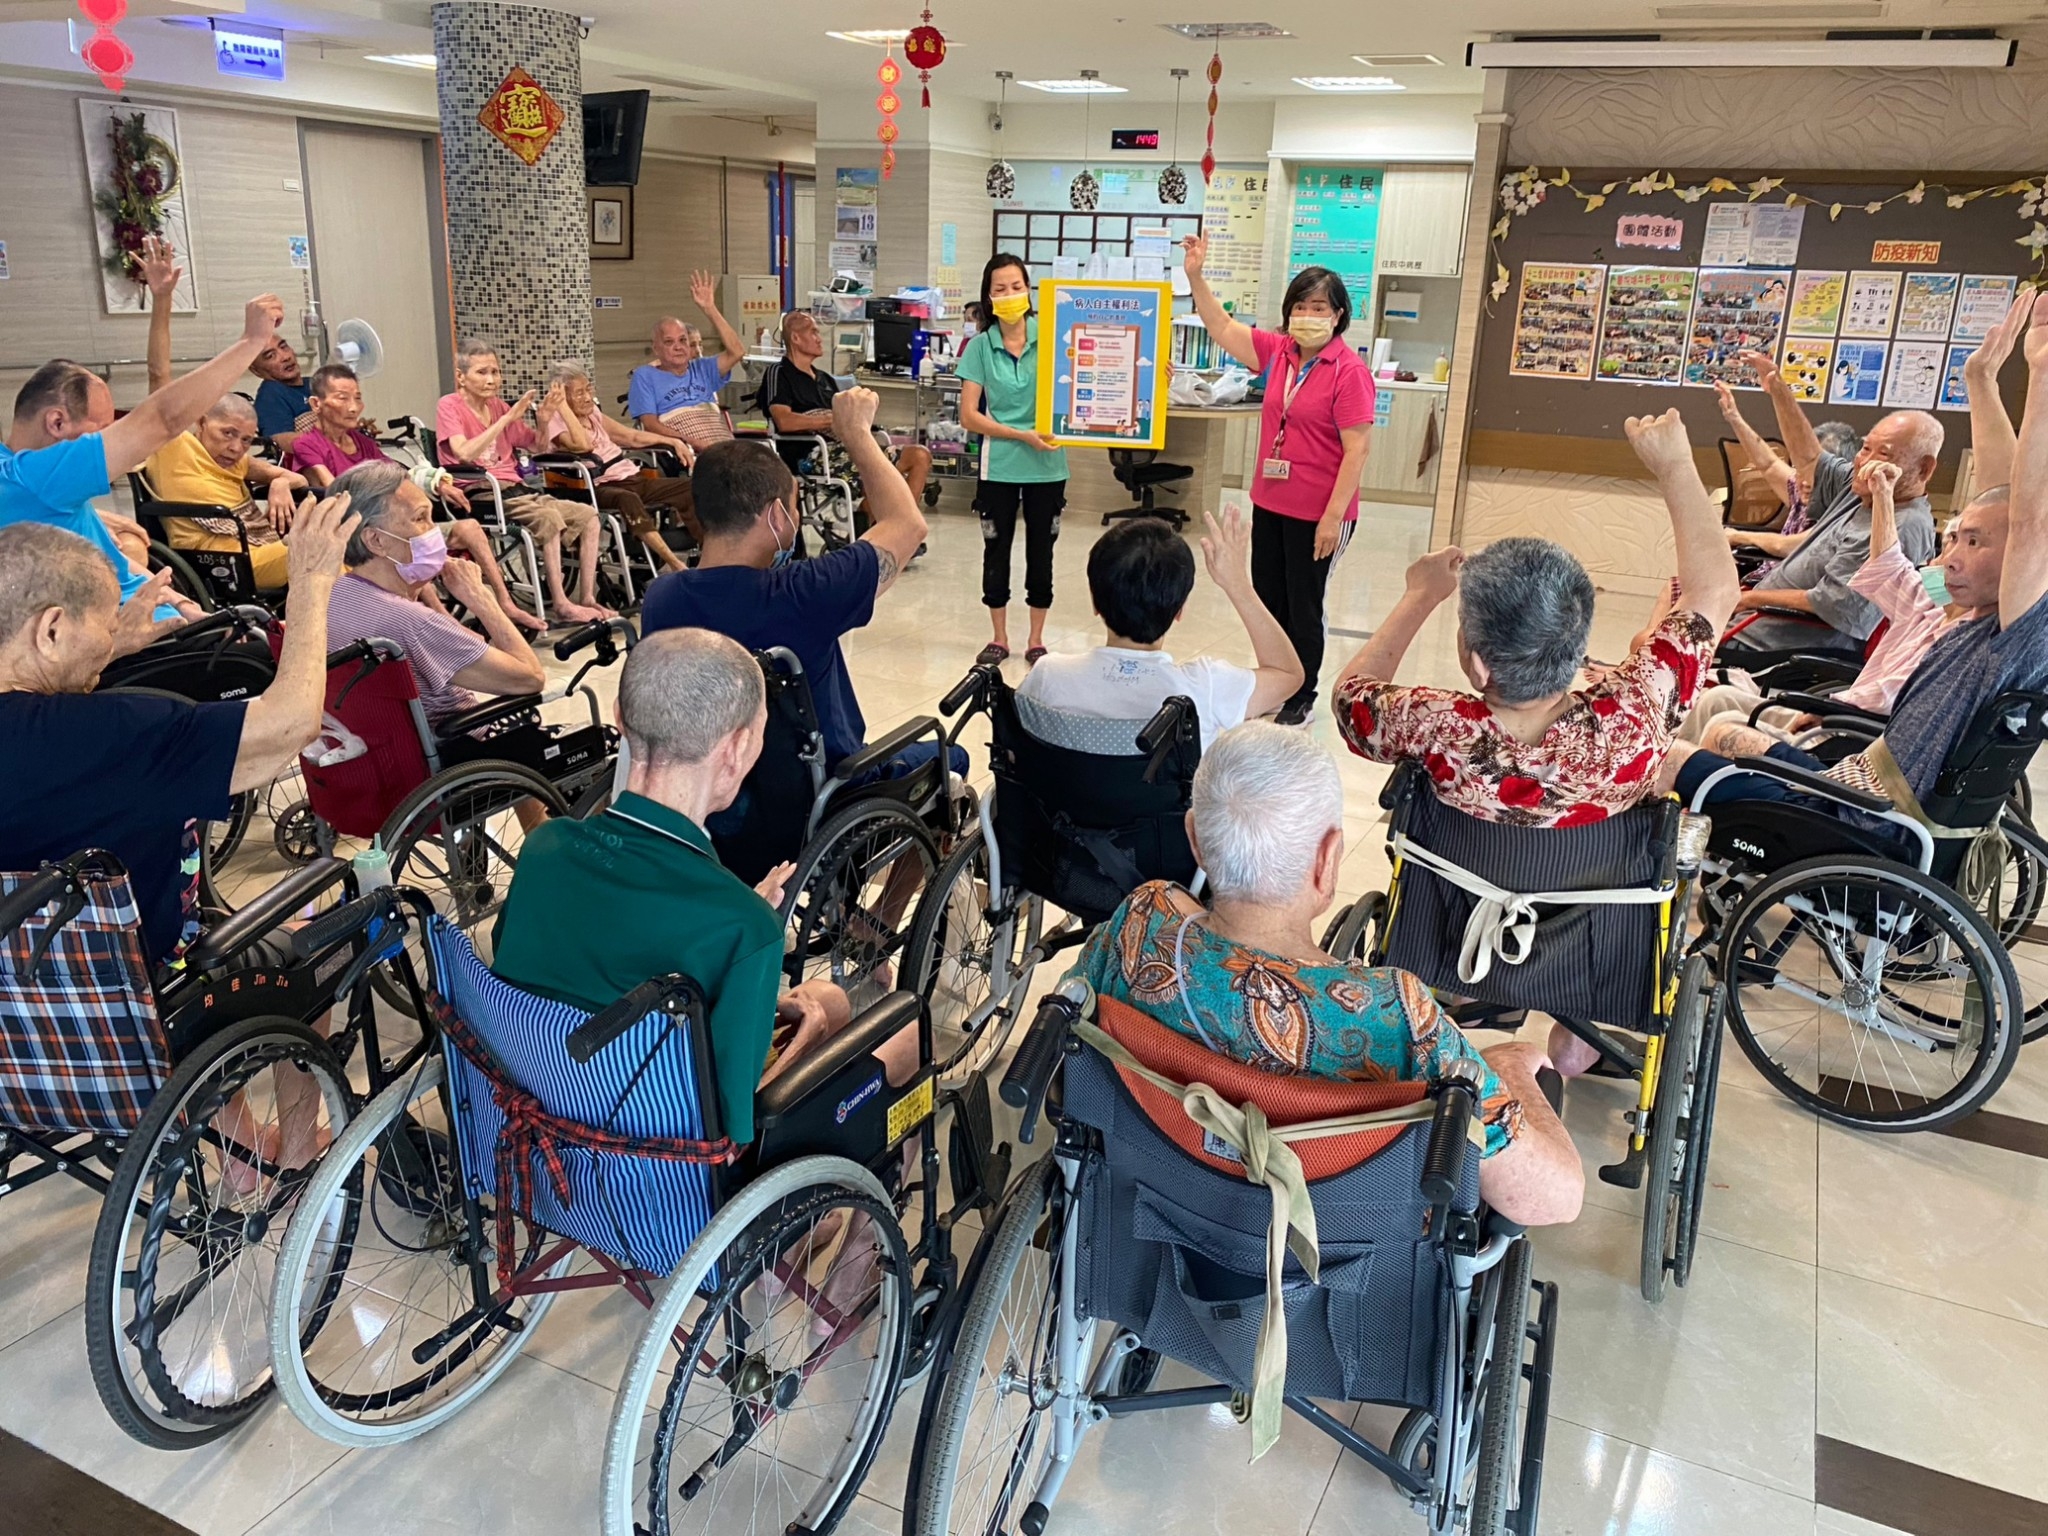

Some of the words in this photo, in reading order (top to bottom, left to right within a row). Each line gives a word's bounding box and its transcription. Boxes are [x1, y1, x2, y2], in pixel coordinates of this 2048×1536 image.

[1135, 134, 1158, 145] 1449
[1339, 174, 1374, 192] 住民
[861, 214, 874, 231] 13
[1623, 223, 1677, 238] 團體活動
[1874, 243, 1939, 262] 防疫新知
[1381, 259, 1423, 270] 住院中病歷
[1074, 298, 1140, 311] 病人自主權利法
[566, 751, 588, 765] SOMA
[1732, 838, 1765, 858] SOMA
